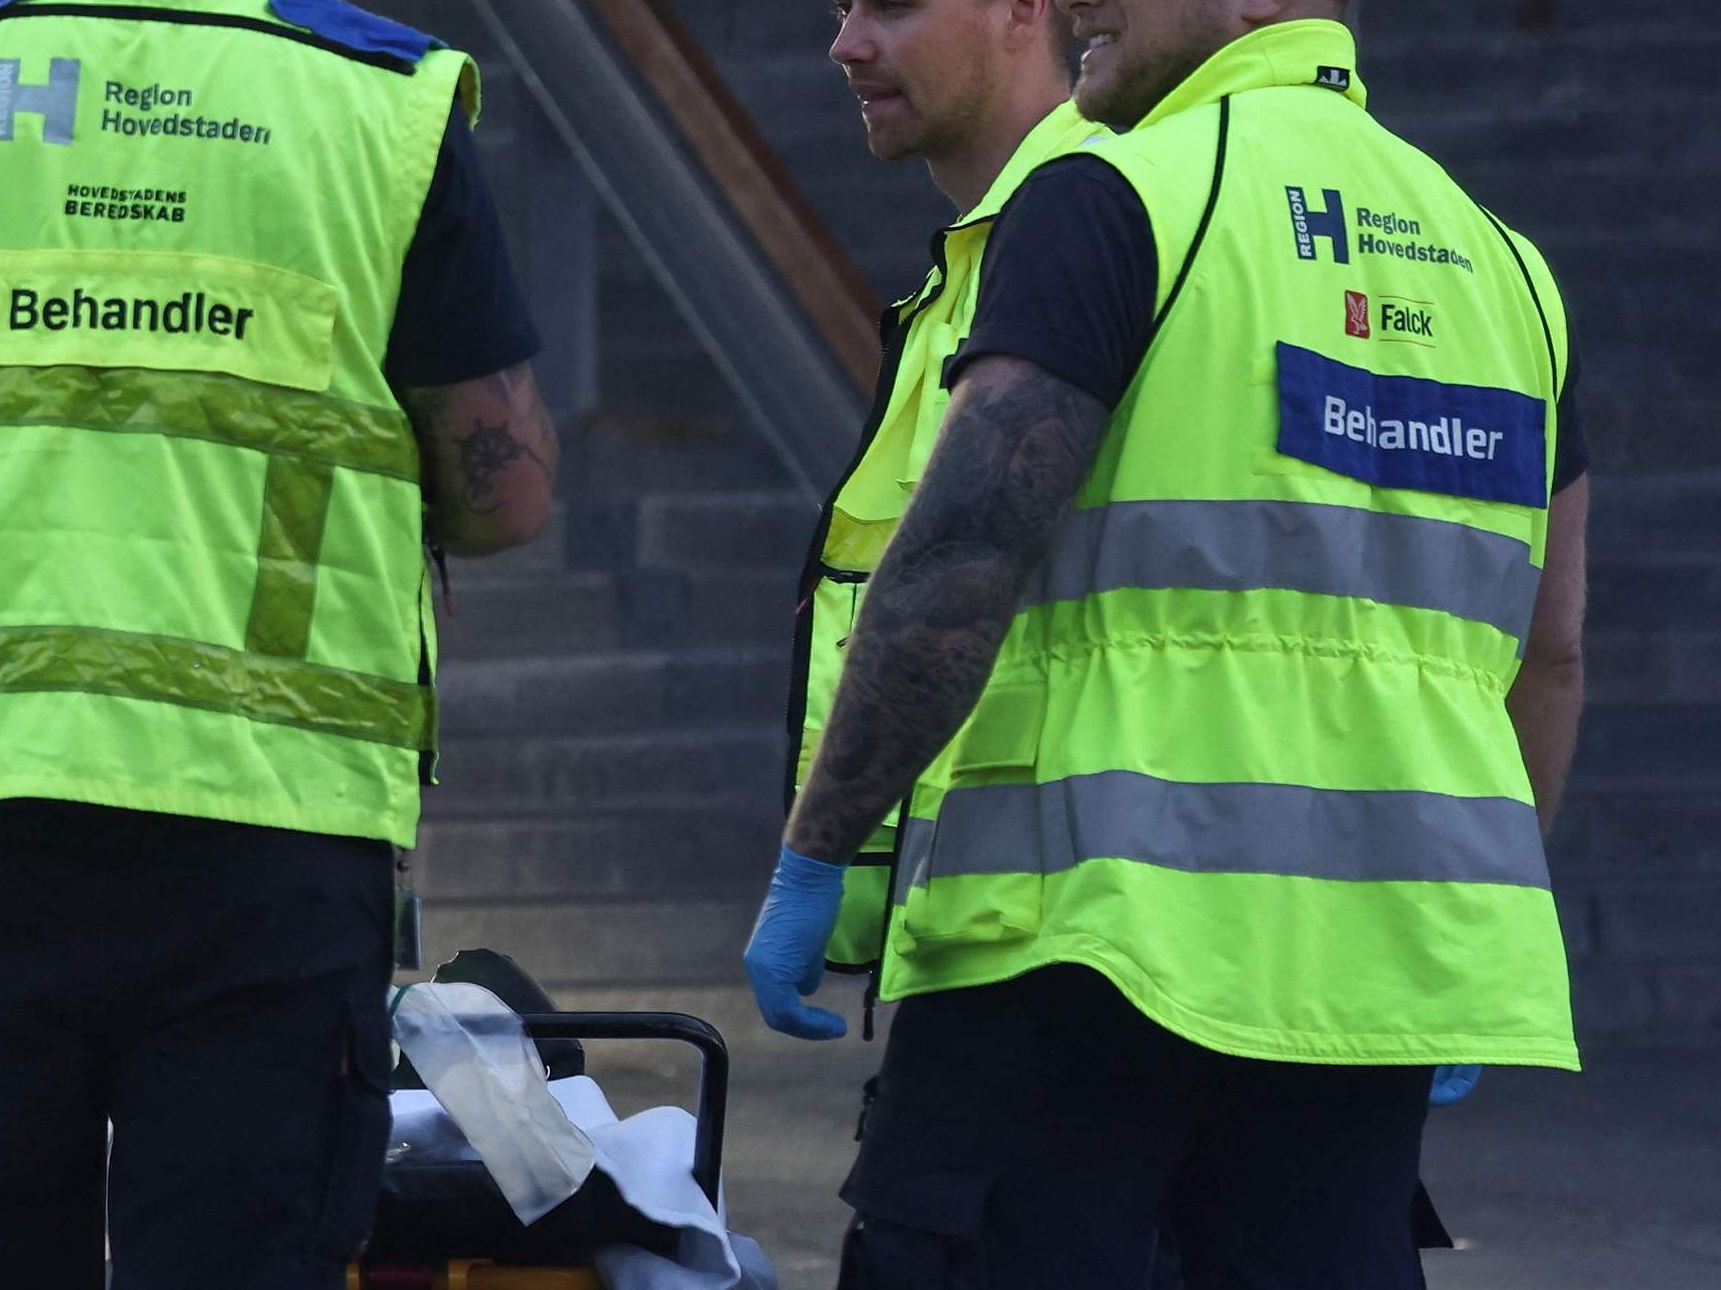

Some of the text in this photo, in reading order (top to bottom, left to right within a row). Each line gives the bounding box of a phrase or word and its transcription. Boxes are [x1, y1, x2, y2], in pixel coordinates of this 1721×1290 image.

[105, 80, 193, 110] Region
[101, 109, 272, 146] Hovedstaden
[65, 200, 185, 222] BEREDSKAB
[67, 184, 187, 203] HOVEDSTADENS
[1290, 190, 1312, 257] REGION
[1357, 207, 1421, 235] Region
[1358, 234, 1473, 274] Hovedstaden
[9, 288, 254, 340] Behandler
[1381, 304, 1433, 337] Falck
[1323, 395, 1504, 460] Behandler
